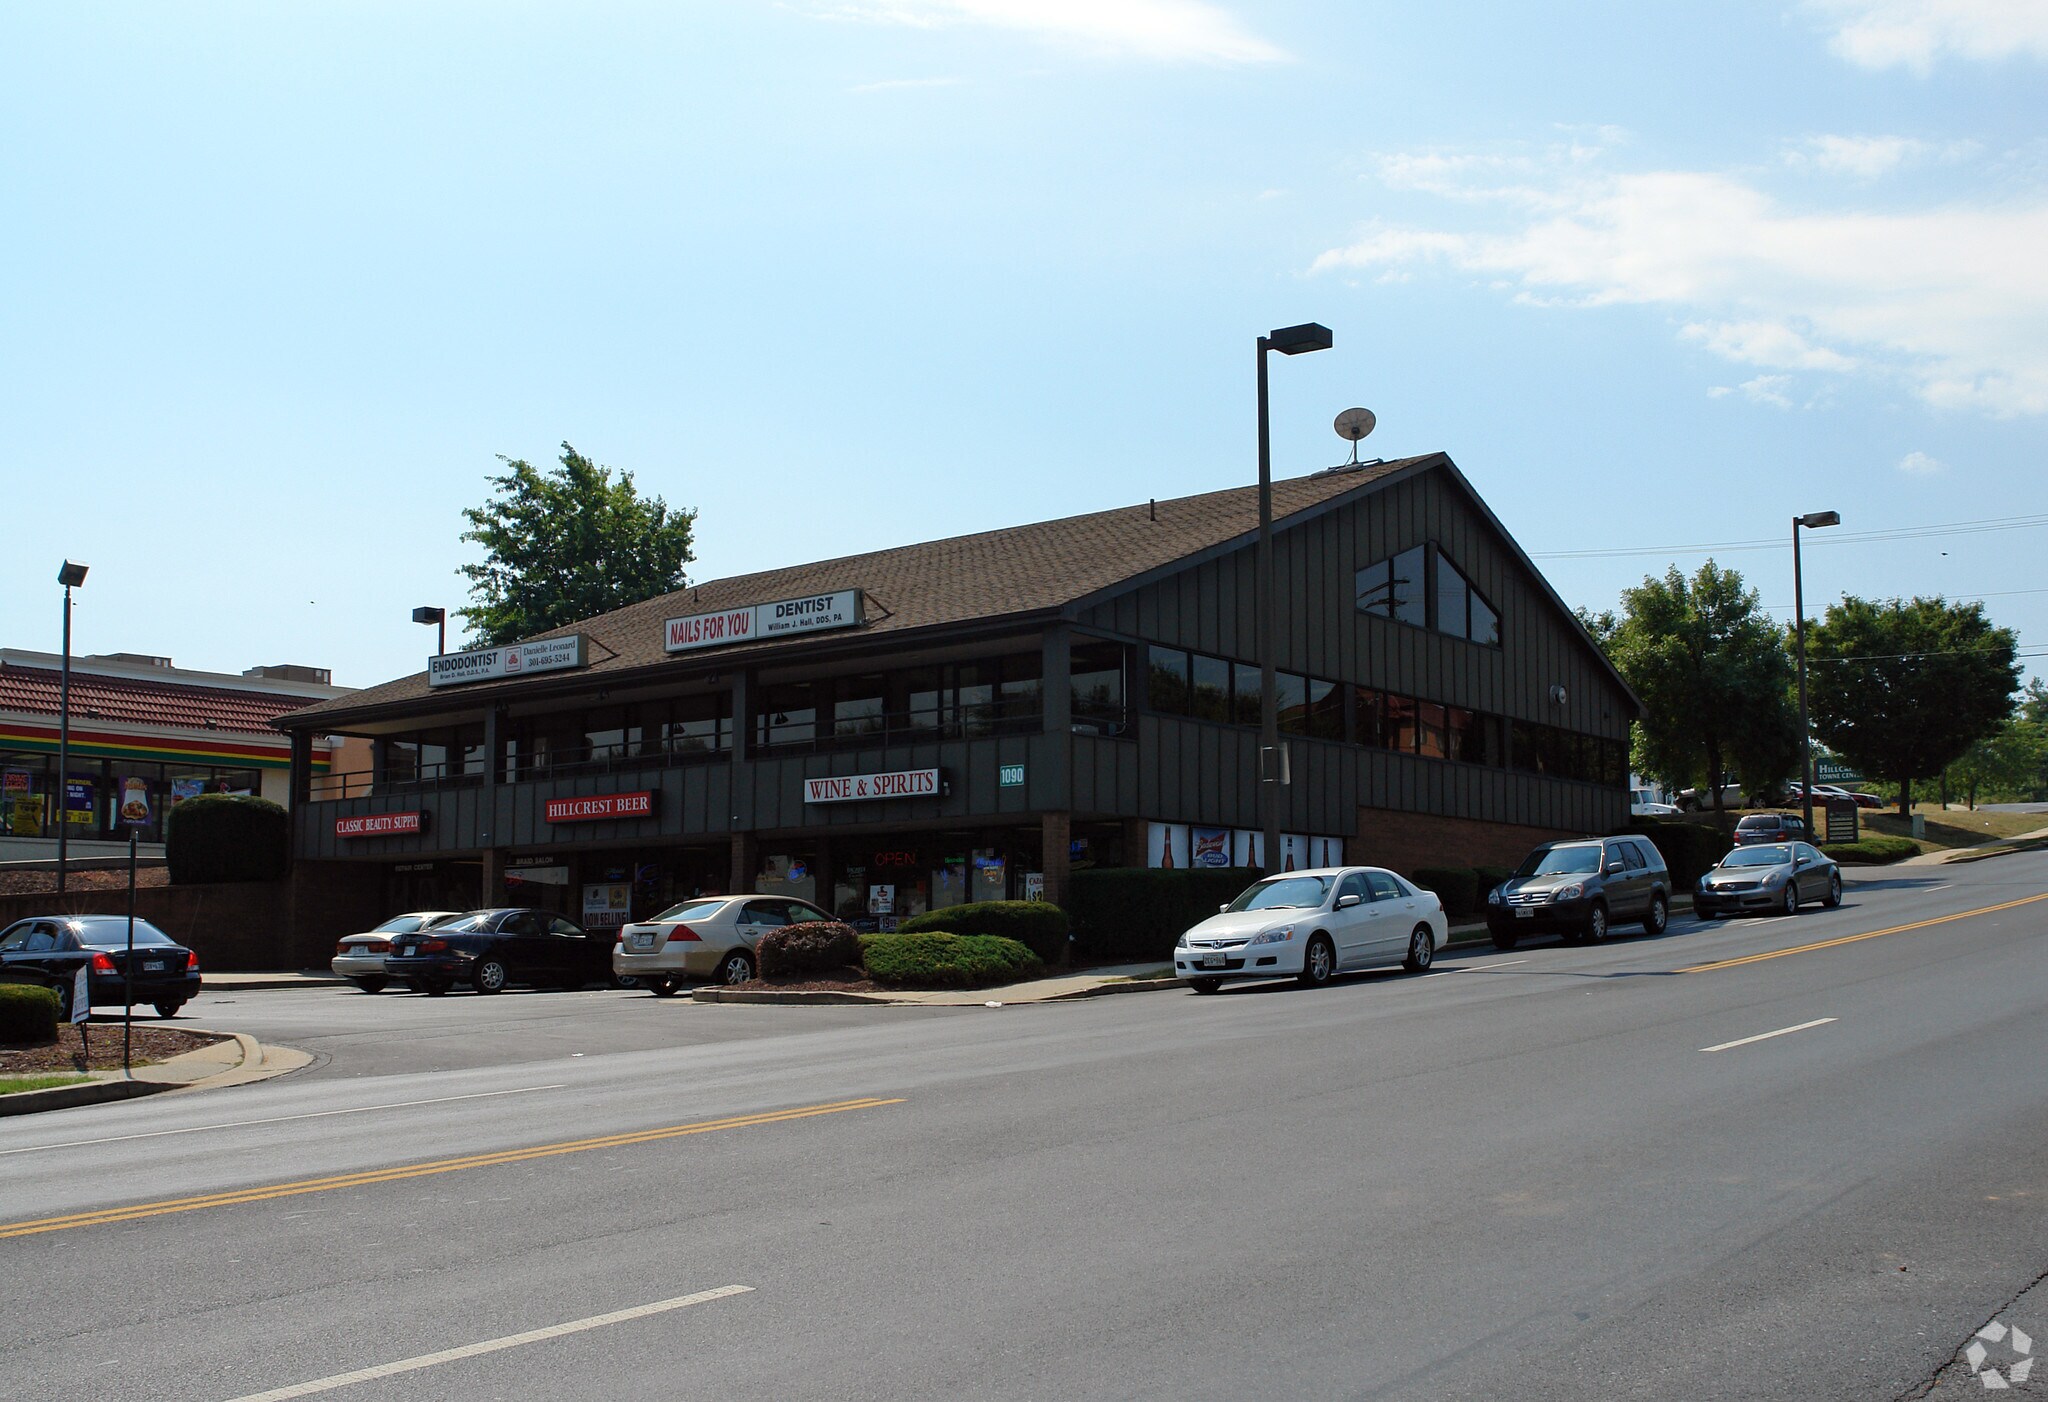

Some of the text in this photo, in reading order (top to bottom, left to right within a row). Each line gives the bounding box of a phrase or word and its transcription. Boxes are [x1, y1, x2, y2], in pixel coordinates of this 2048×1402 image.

[776, 596, 834, 618] DENTIST
[670, 611, 749, 645] NAILS FOR YOU
[768, 613, 842, 632] William J. Hall, DDS, PA
[523, 640, 576, 656] Danielle Leonard
[432, 652, 498, 673] ENDODONTIST
[528, 653, 570, 667] 301-695-5244
[440, 671, 451, 680] Brian
[1001, 768, 1023, 784] 1090
[809, 771, 934, 800] WINE & SPIRITS
[549, 796, 649, 817] HILLCREST BEER
[336, 815, 420, 833] CLASSIC BEAUTY SUPPLY
[413, 863, 433, 871] CENTER
[535, 856, 553, 864] SALON
[875, 852, 915, 867] OPEN
[585, 912, 600, 928] NOW
